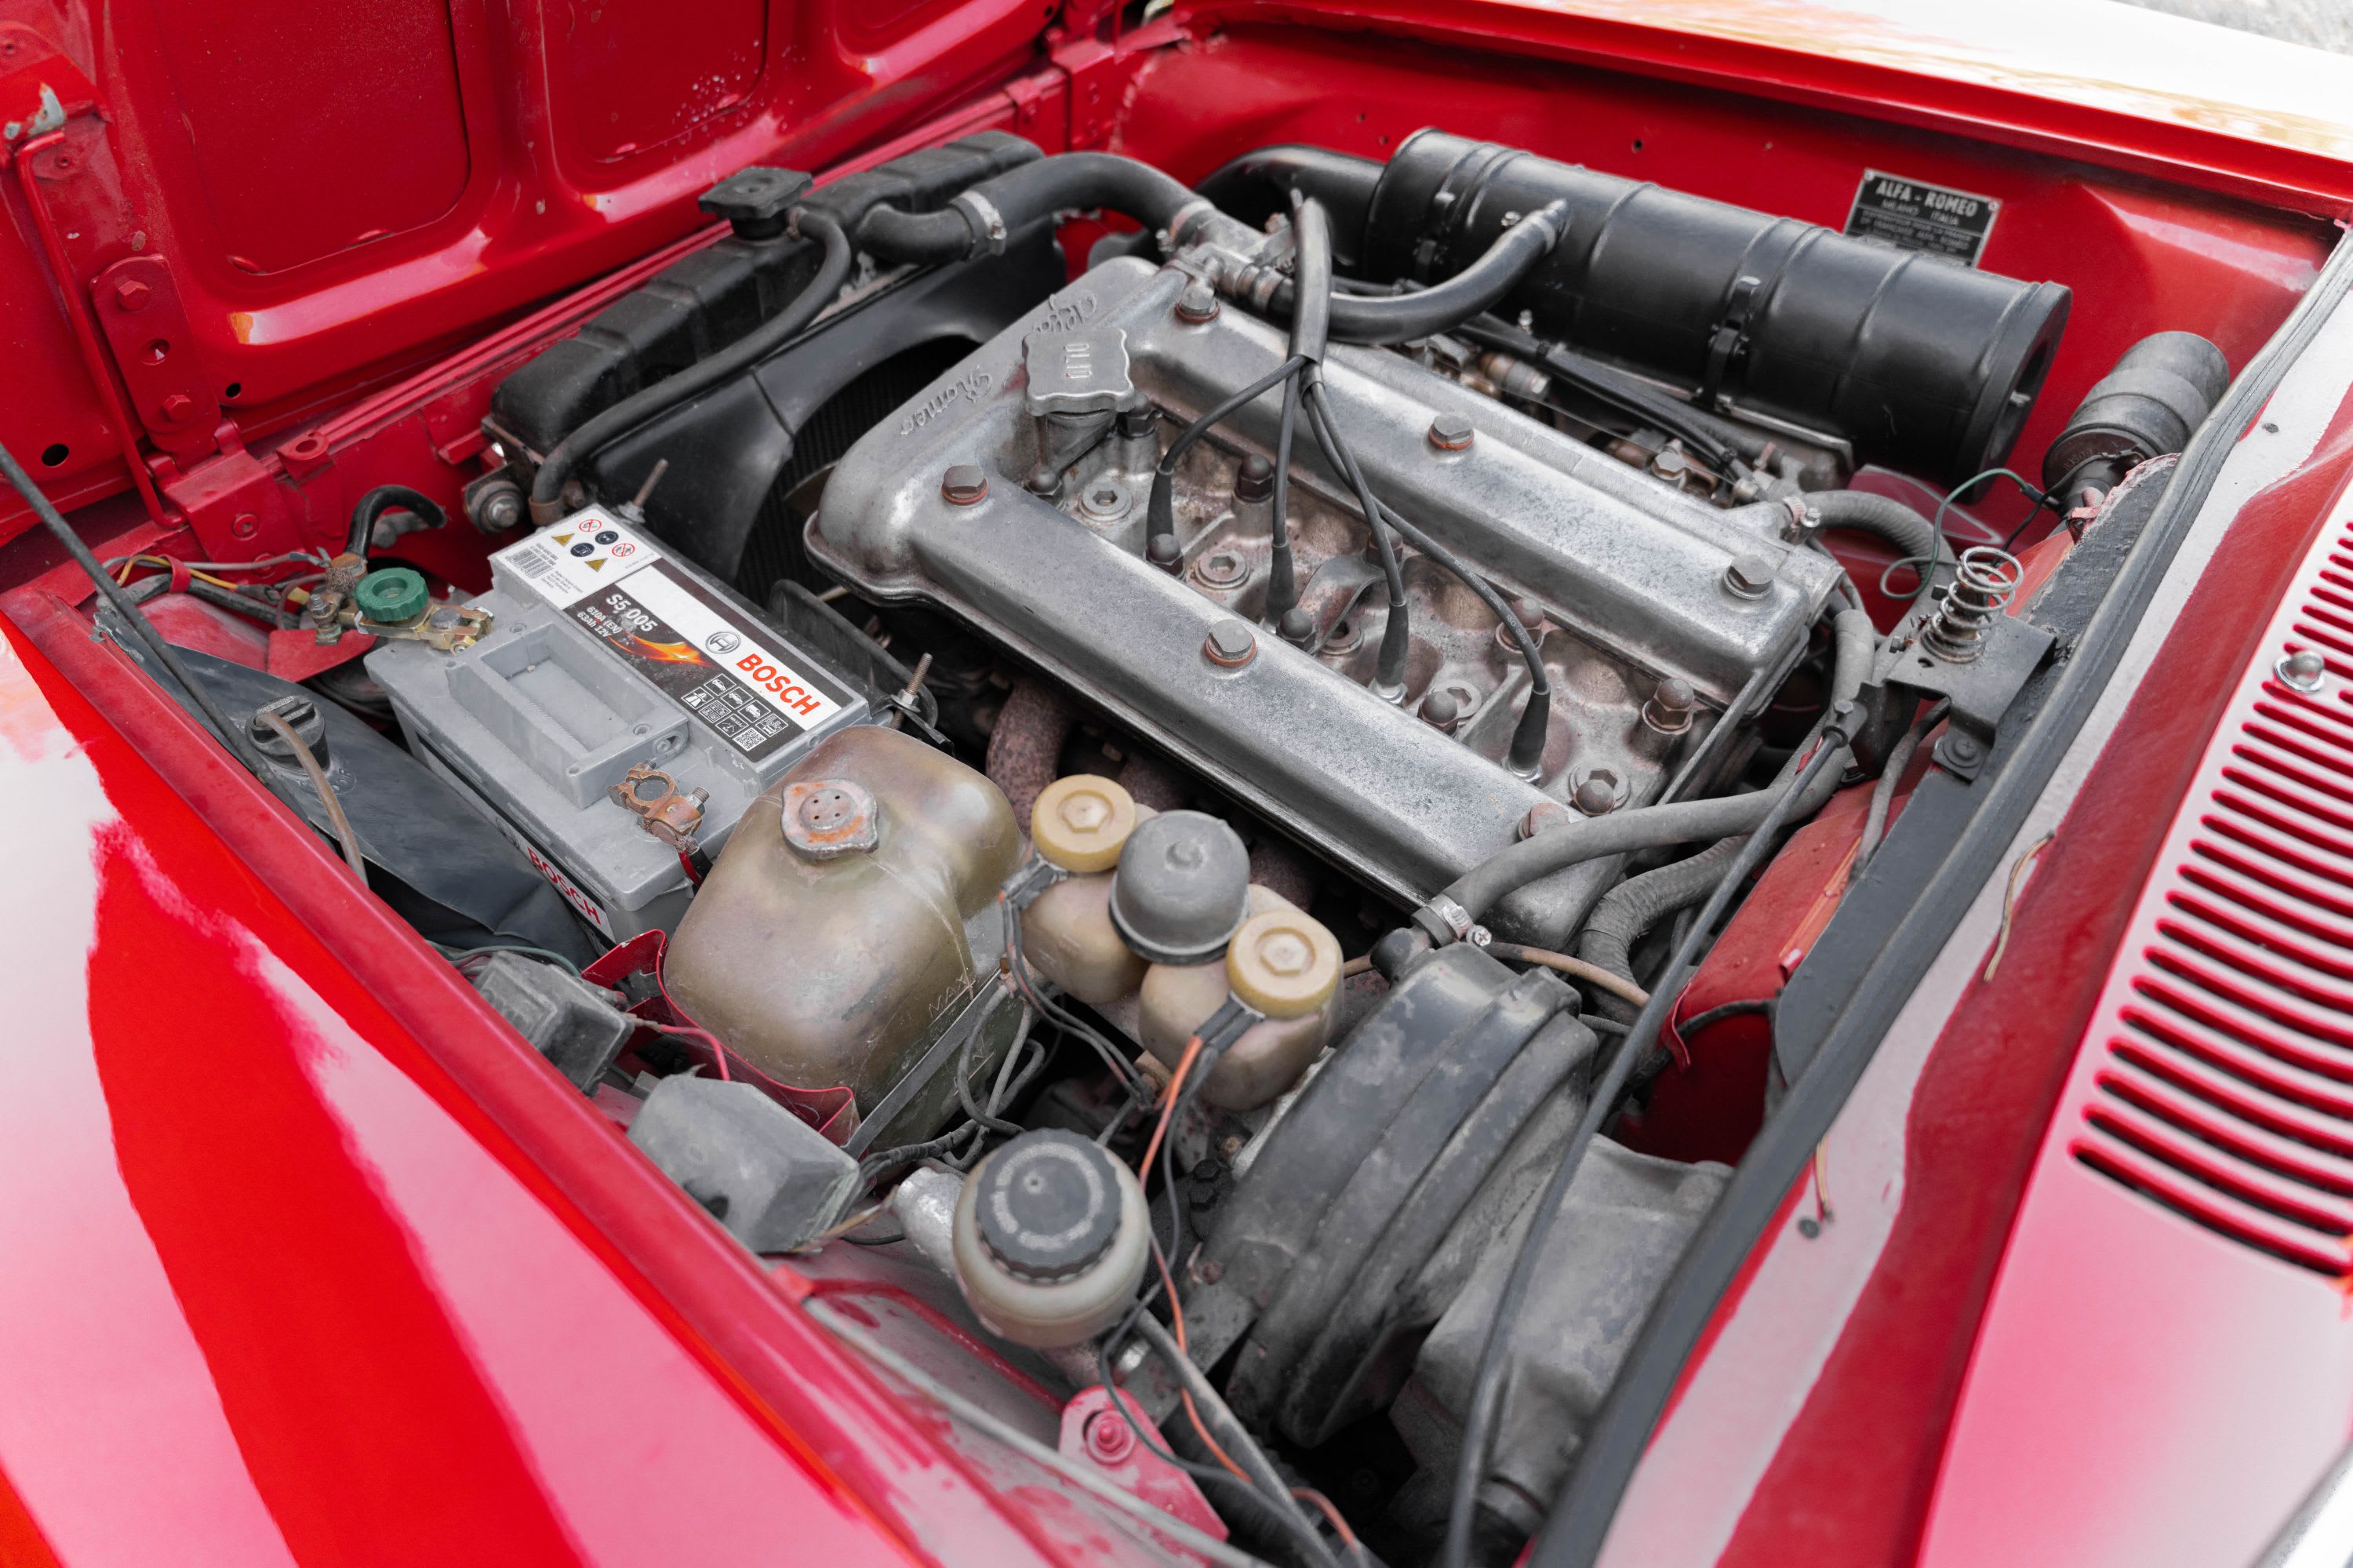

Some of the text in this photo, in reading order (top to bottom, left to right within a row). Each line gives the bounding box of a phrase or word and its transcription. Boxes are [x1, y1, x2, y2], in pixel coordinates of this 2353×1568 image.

[1875, 181, 1911, 202] ALFA
[1924, 191, 1978, 217] ROMEO
[1930, 211, 1959, 226] ITALIA
[577, 612, 610, 637] 63Ah 12V
[587, 606, 623, 635] 610A (EN)
[606, 594, 658, 631] S5 005
[736, 653, 821, 715] BOSCH
[527, 846, 602, 925] BOSCH
